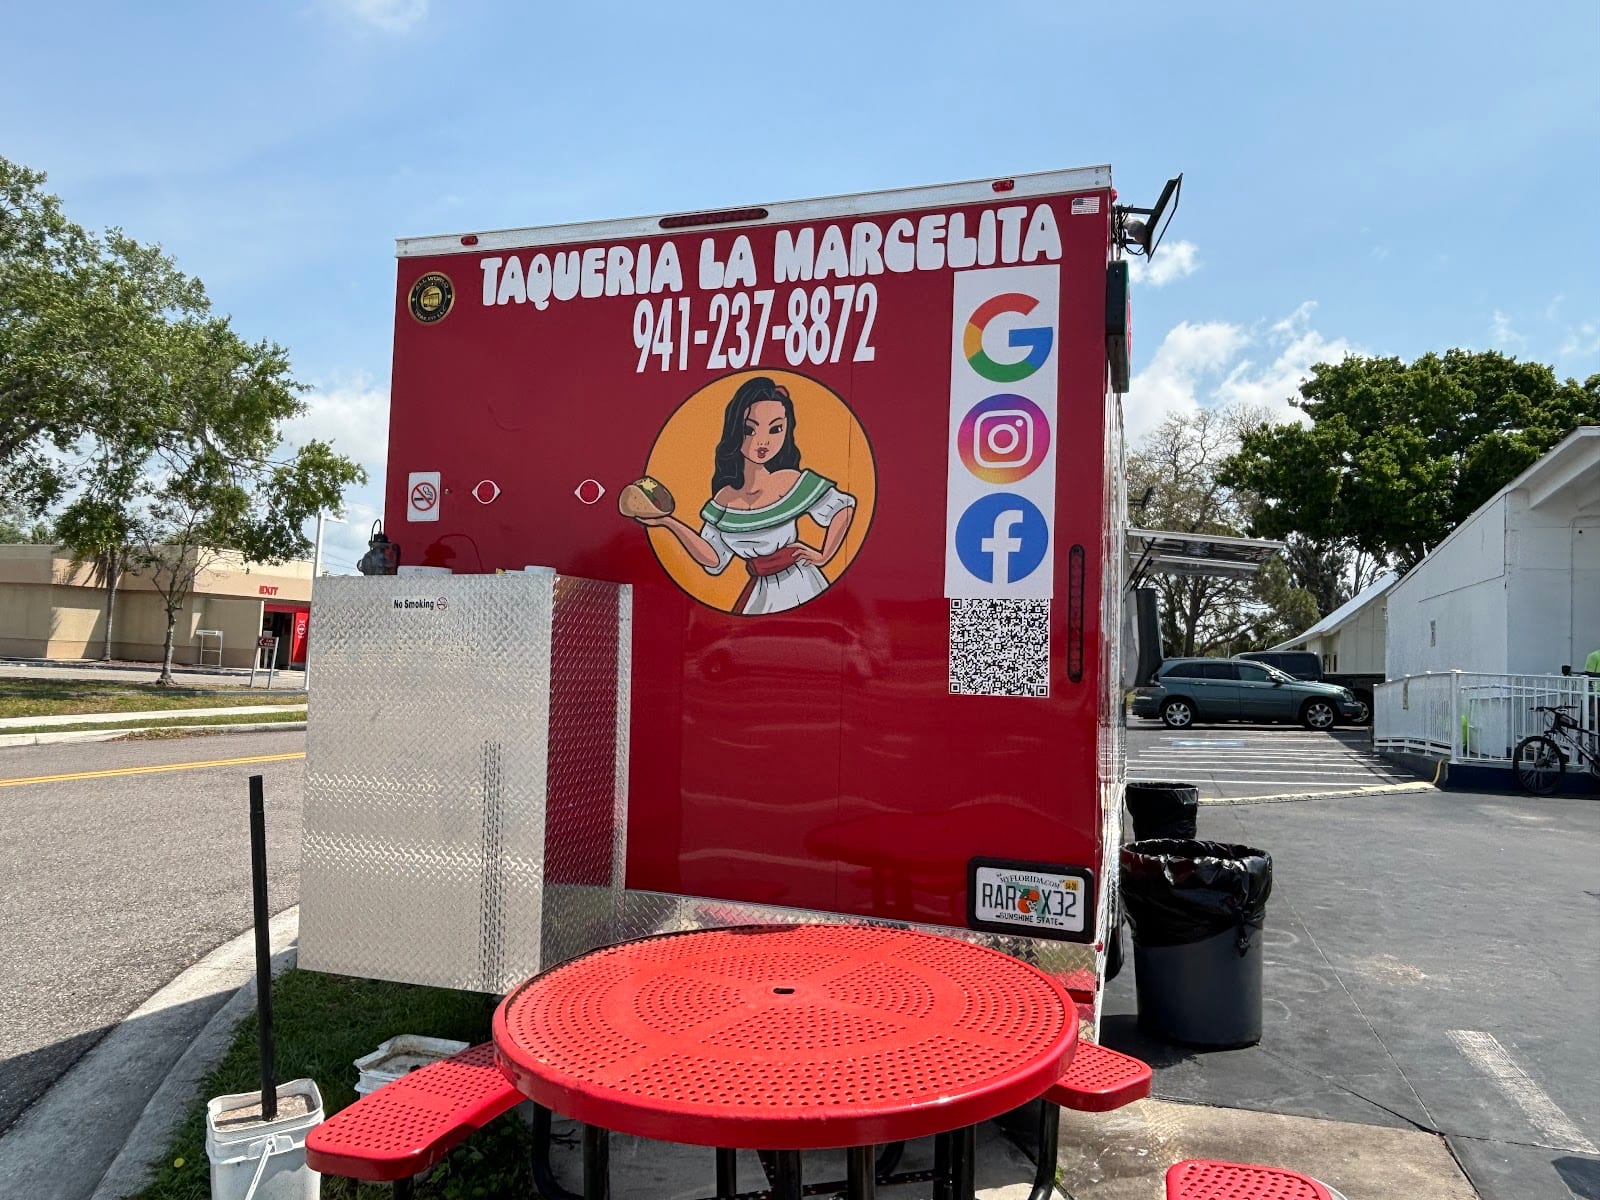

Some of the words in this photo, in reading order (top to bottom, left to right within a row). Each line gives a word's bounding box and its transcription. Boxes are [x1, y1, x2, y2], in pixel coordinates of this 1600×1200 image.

[480, 241, 684, 311] TAQUERIA
[699, 235, 757, 290] LA
[774, 203, 1063, 284] MARCELITA
[633, 282, 878, 373] 941-237-8872
[963, 292, 1053, 383] G
[259, 585, 279, 595] EXIT
[394, 599, 403, 609] No
[404, 598, 434, 611] Smoking
[982, 883, 1016, 911] RAR
[1041, 889, 1077, 918] X32
[999, 912, 1034, 923] SUNSHINE
[1036, 916, 1059, 926] STATE
